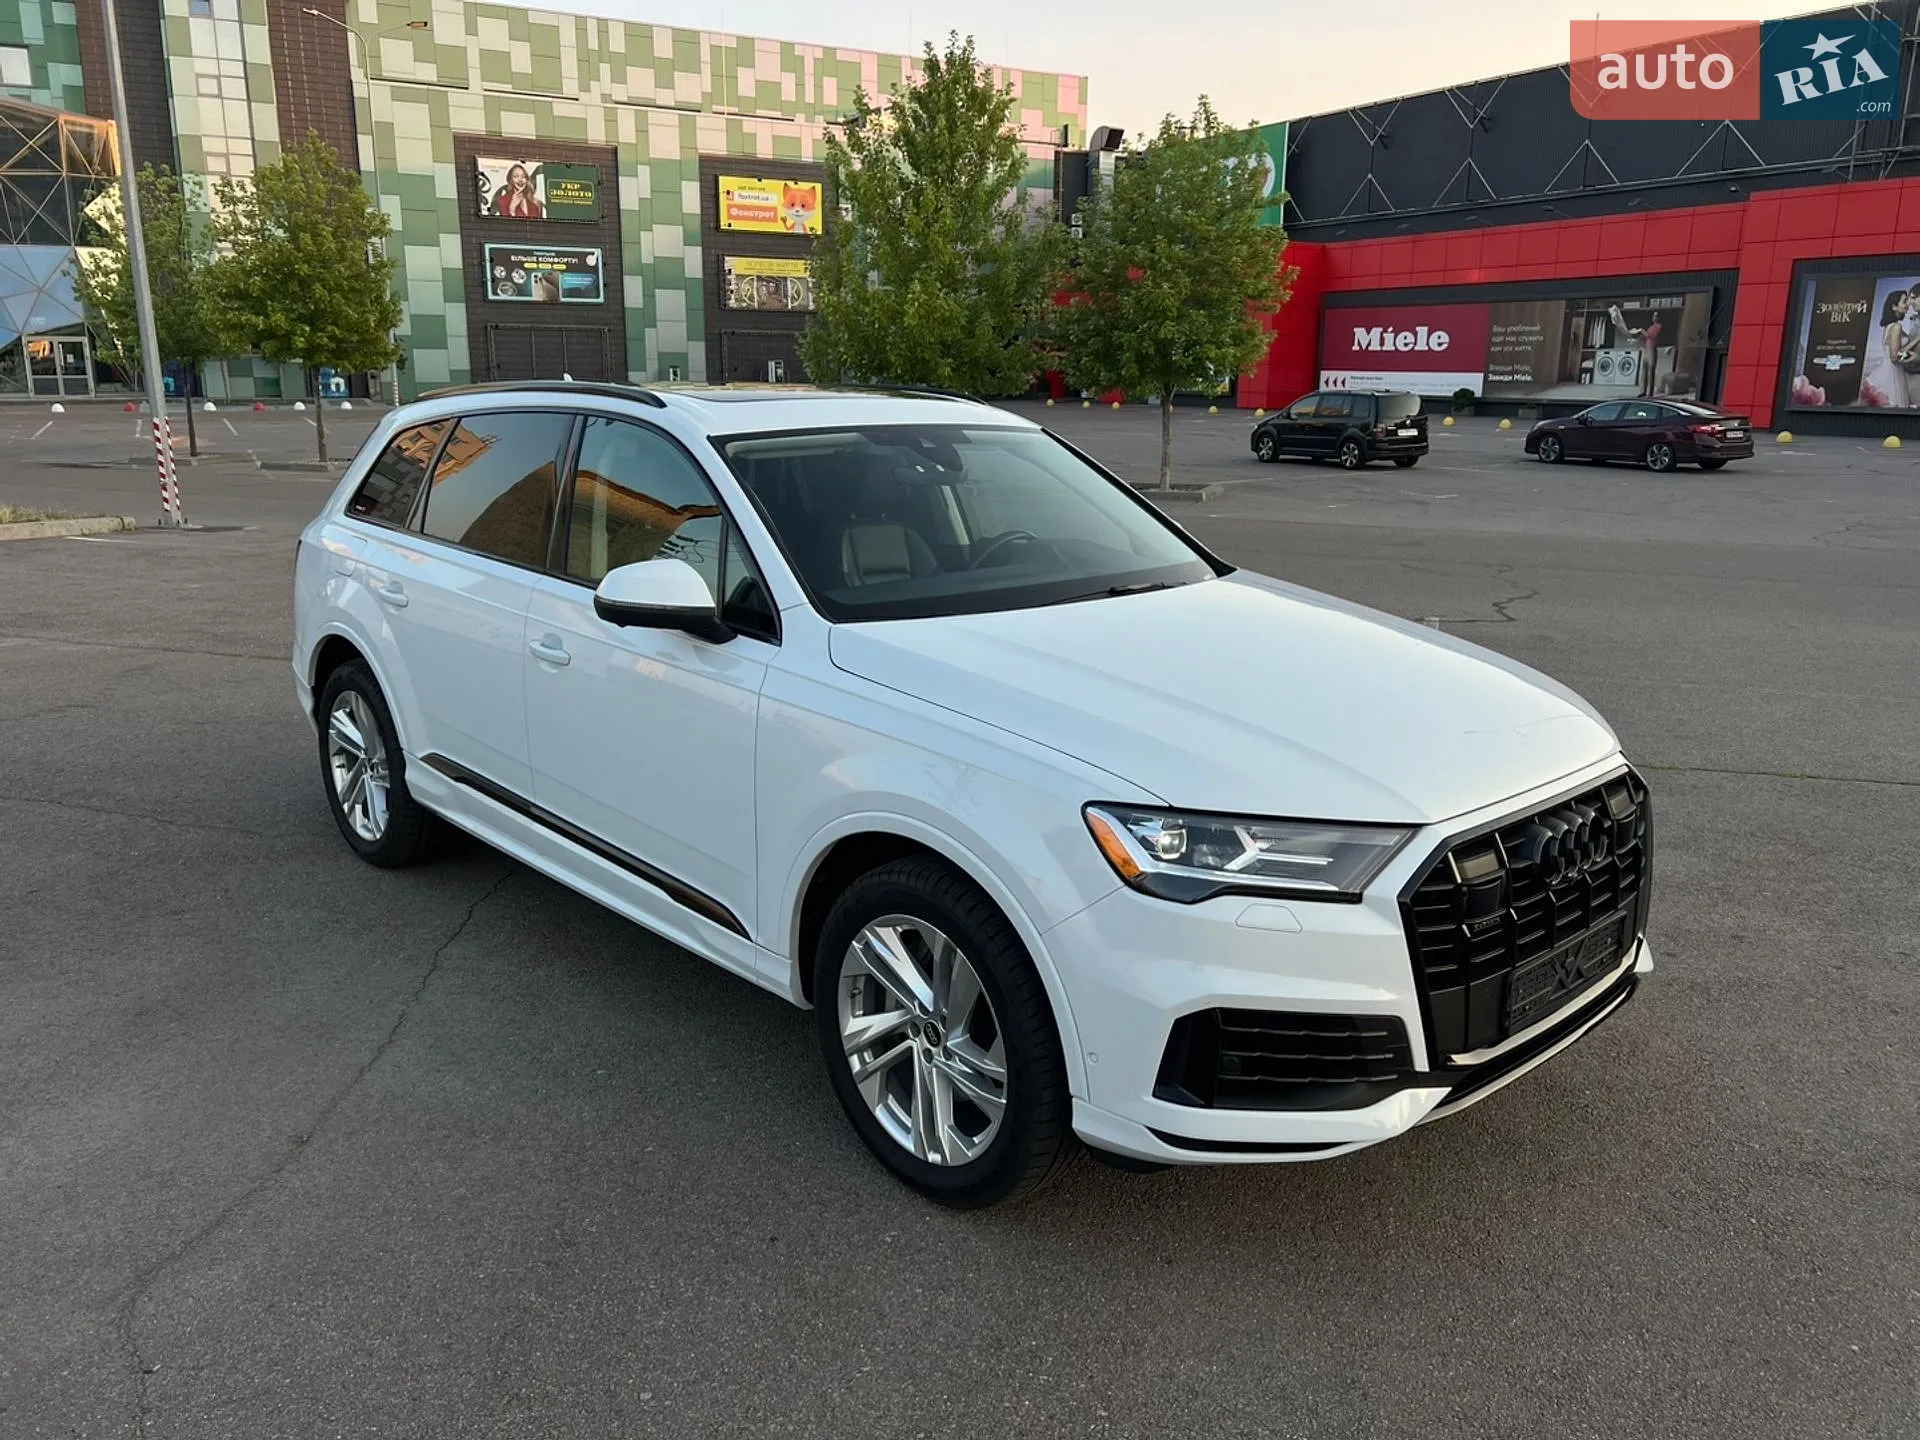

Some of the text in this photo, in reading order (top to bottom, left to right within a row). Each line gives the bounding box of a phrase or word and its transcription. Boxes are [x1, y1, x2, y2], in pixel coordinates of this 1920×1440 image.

[561, 182, 581, 190] УКР
[550, 189, 592, 198] ЗОЛОТО
[511, 255, 537, 263] БІЛЬШЕ
[1352, 326, 1450, 351] Miele
